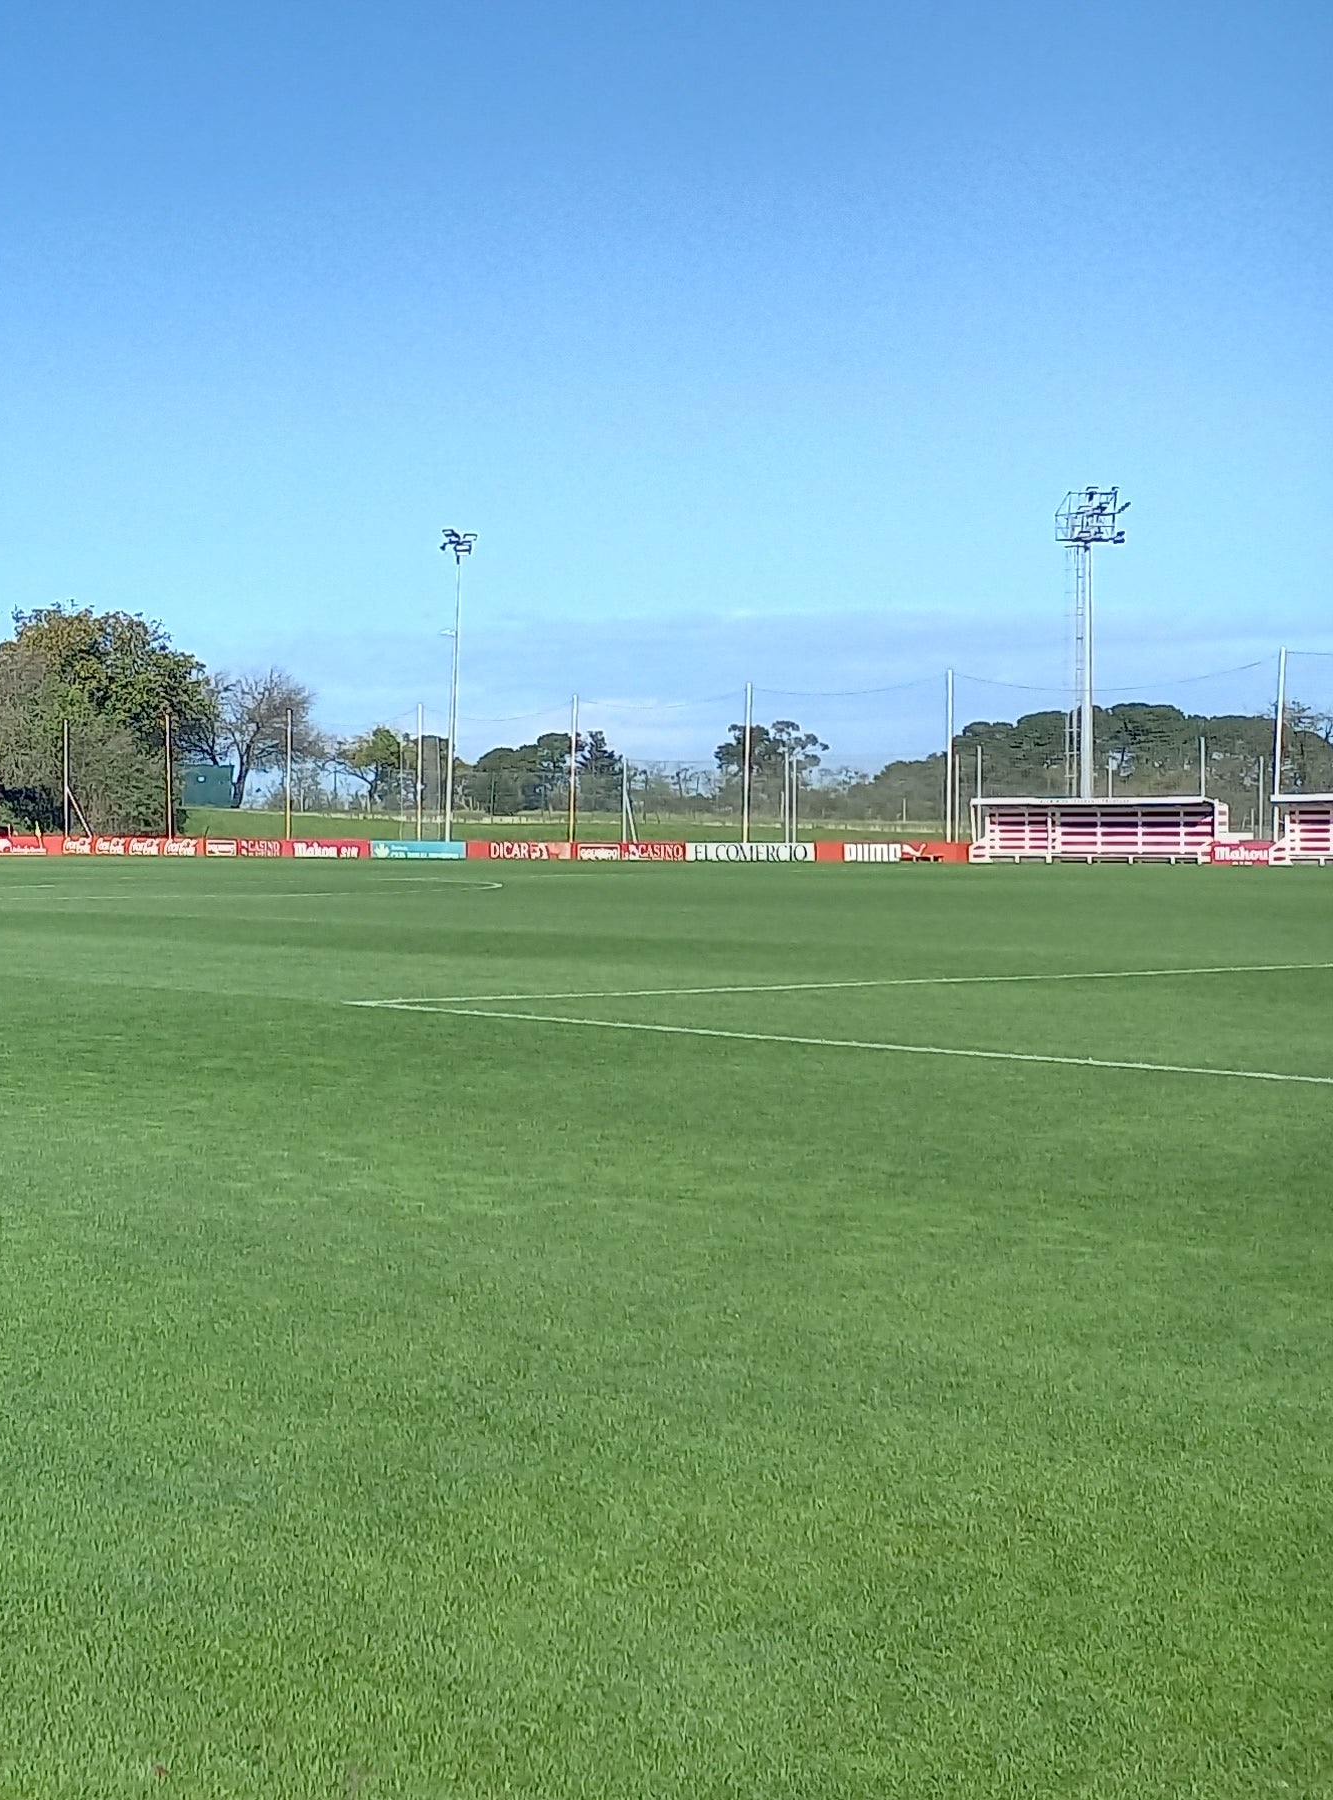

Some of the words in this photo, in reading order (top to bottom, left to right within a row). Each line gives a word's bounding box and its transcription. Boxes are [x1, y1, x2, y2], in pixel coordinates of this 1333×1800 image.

[293, 841, 338, 858] Mahou
[639, 844, 683, 858] CASINO
[695, 844, 713, 861] EL
[716, 844, 807, 861] COMERCIO
[1214, 845, 1269, 861] Mahou
